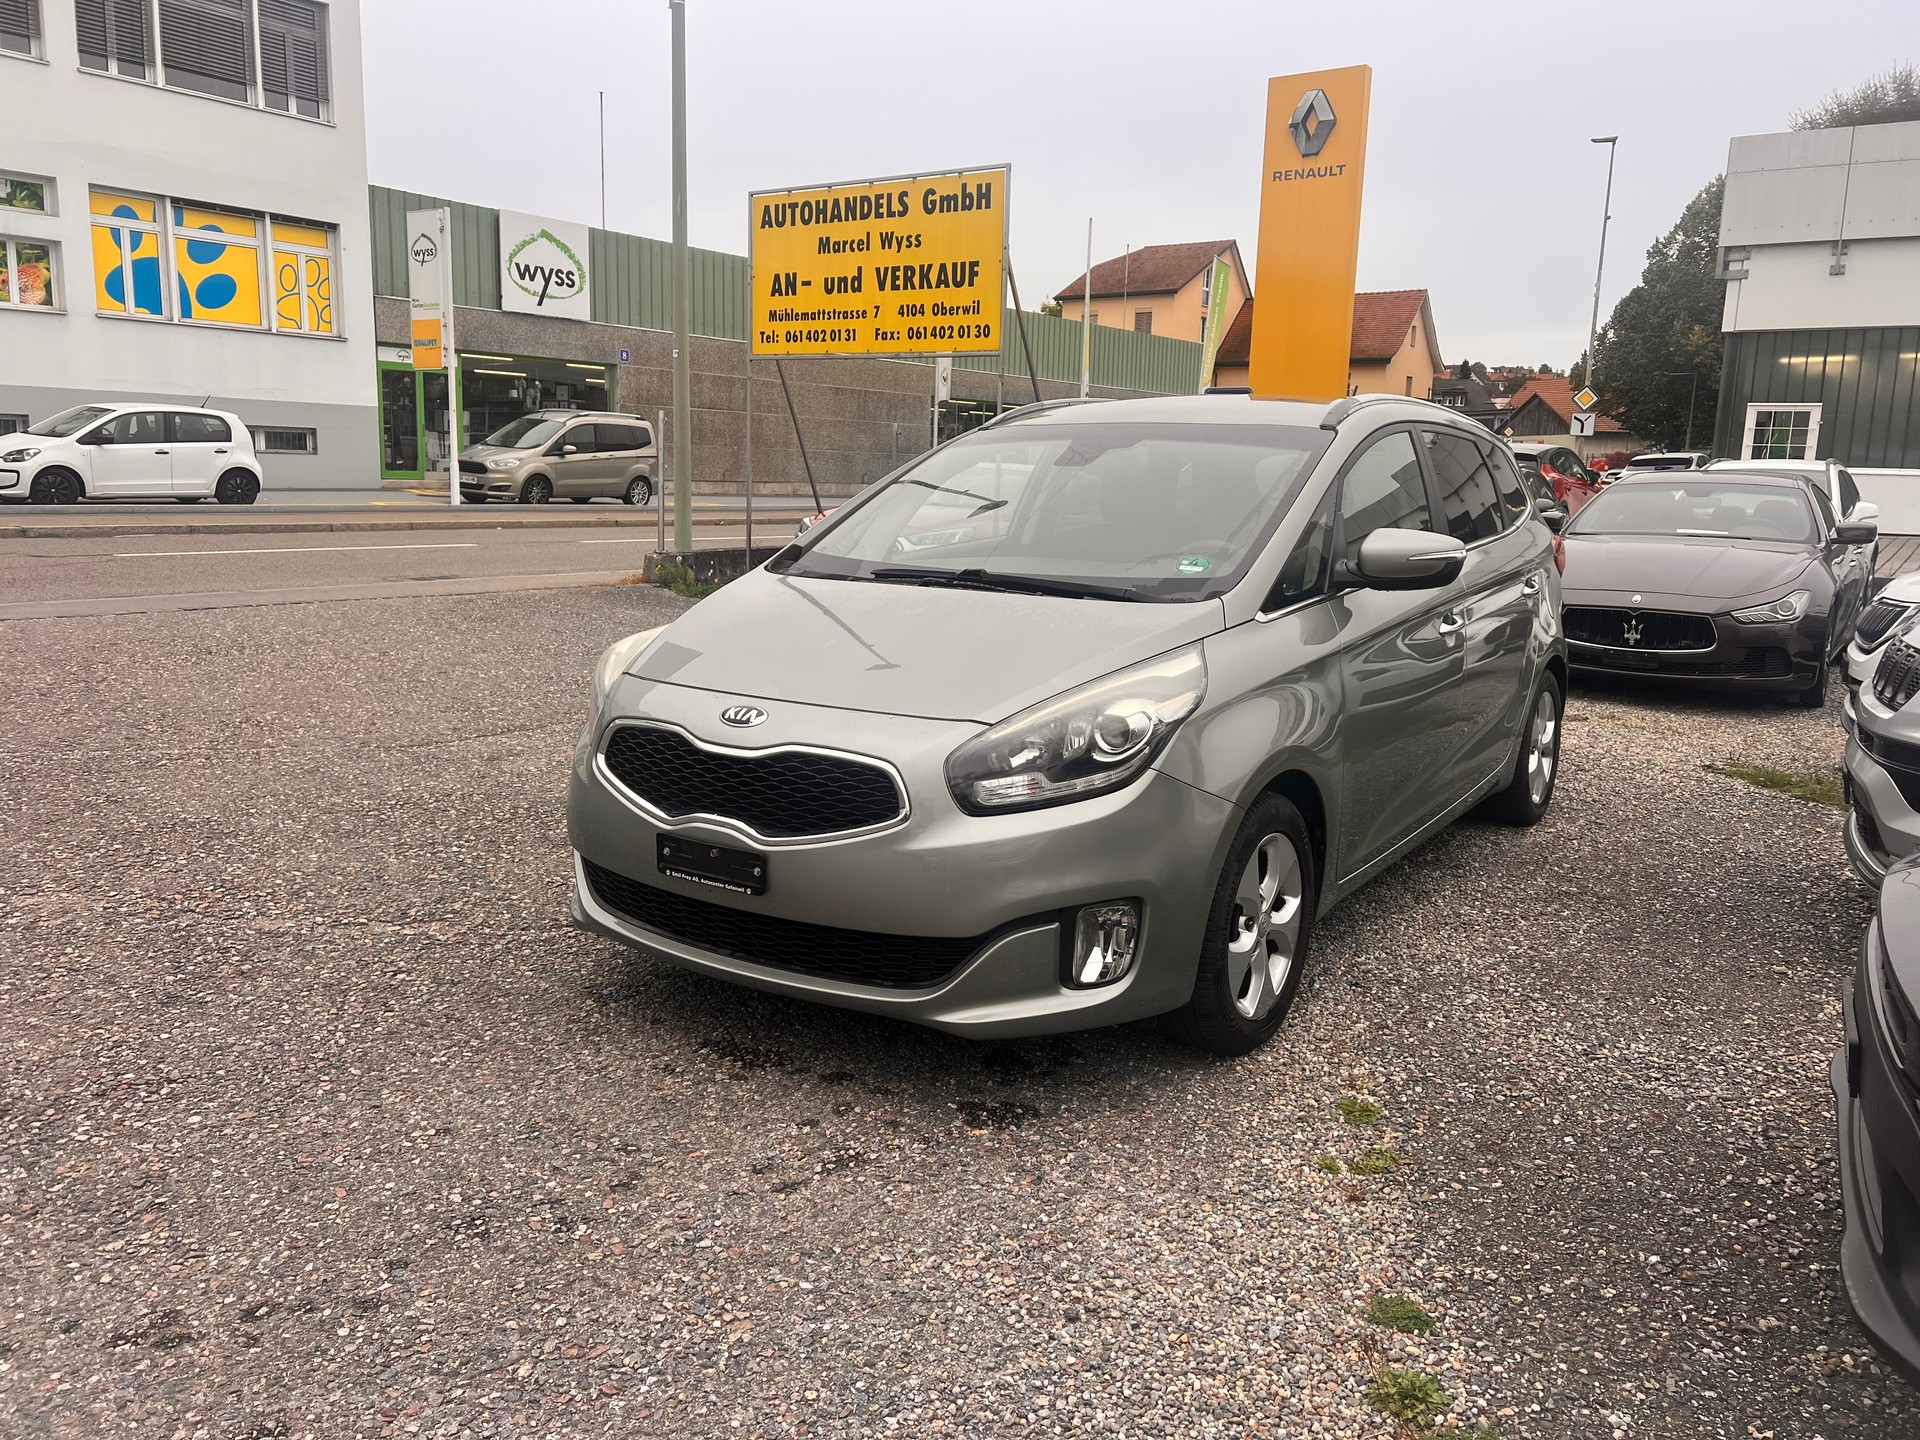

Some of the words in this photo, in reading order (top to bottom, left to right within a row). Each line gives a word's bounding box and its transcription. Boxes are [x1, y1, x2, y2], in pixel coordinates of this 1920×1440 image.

[1273, 164, 1347, 182] RENAULT
[760, 190, 909, 229] AUTOHANDELS
[922, 182, 992, 216] GmbH
[818, 232, 871, 254] Marcel
[879, 231, 922, 254] Wyss
[413, 247, 434, 267] wyss
[515, 262, 576, 307] wyss
[823, 266, 863, 295] und
[875, 260, 980, 292] VERKAUF
[768, 308, 868, 323] Mühlemattstrasse
[873, 305, 881, 319] 7
[897, 304, 926, 318] 4104
[931, 300, 981, 317] Oberwil
[759, 330, 779, 343] Tel:
[875, 328, 900, 341] Fax:
[622, 351, 628, 360] 8
[724, 706, 758, 723] KIA
[682, 873, 692, 881] Frey
[701, 878, 725, 888] Autocenter
